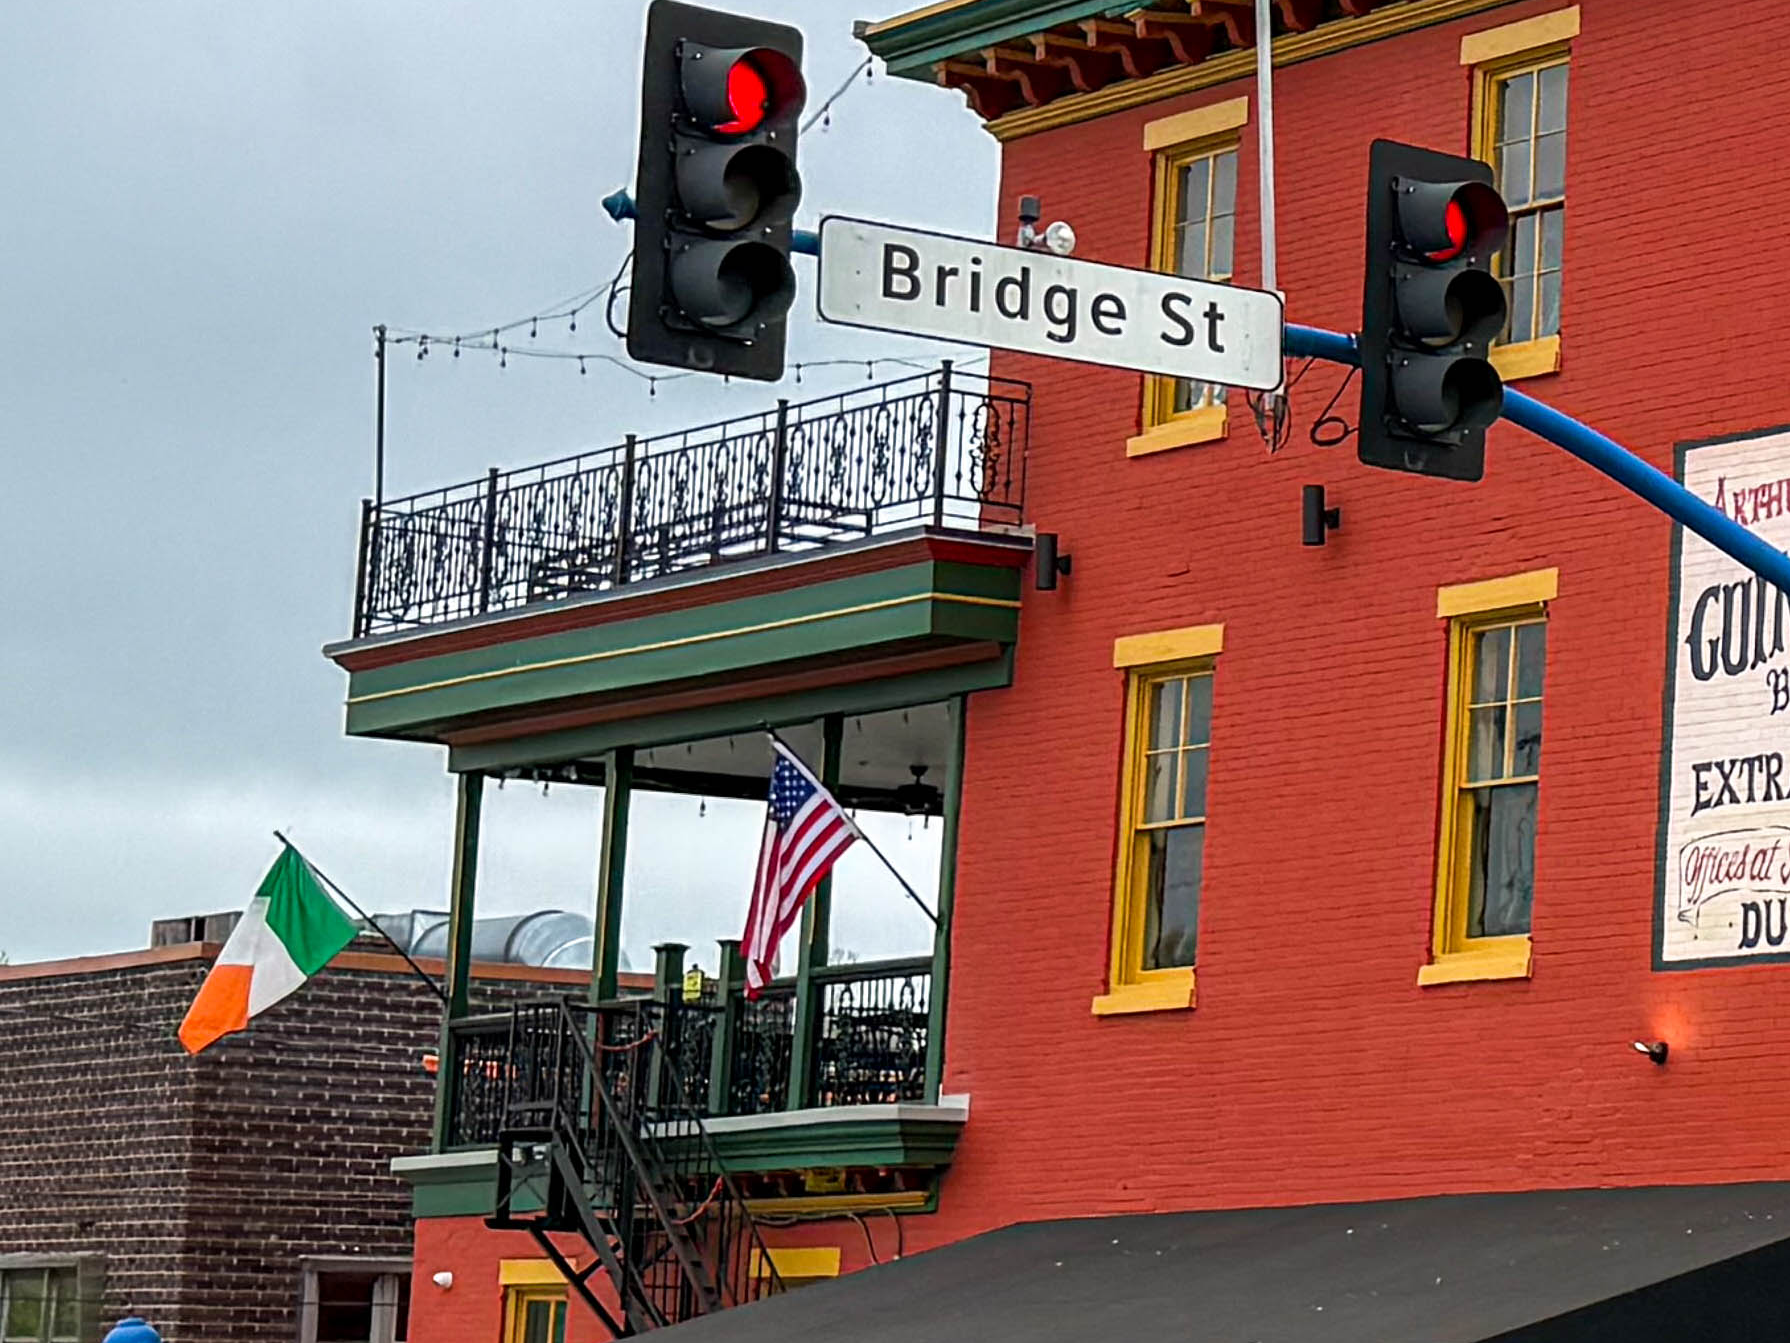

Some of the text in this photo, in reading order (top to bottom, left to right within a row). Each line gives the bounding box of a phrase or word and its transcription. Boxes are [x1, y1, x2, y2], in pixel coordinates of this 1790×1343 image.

[881, 243, 1225, 353] Bridge St
[1684, 843, 1750, 905] Offices
[1750, 838, 1783, 881] at
